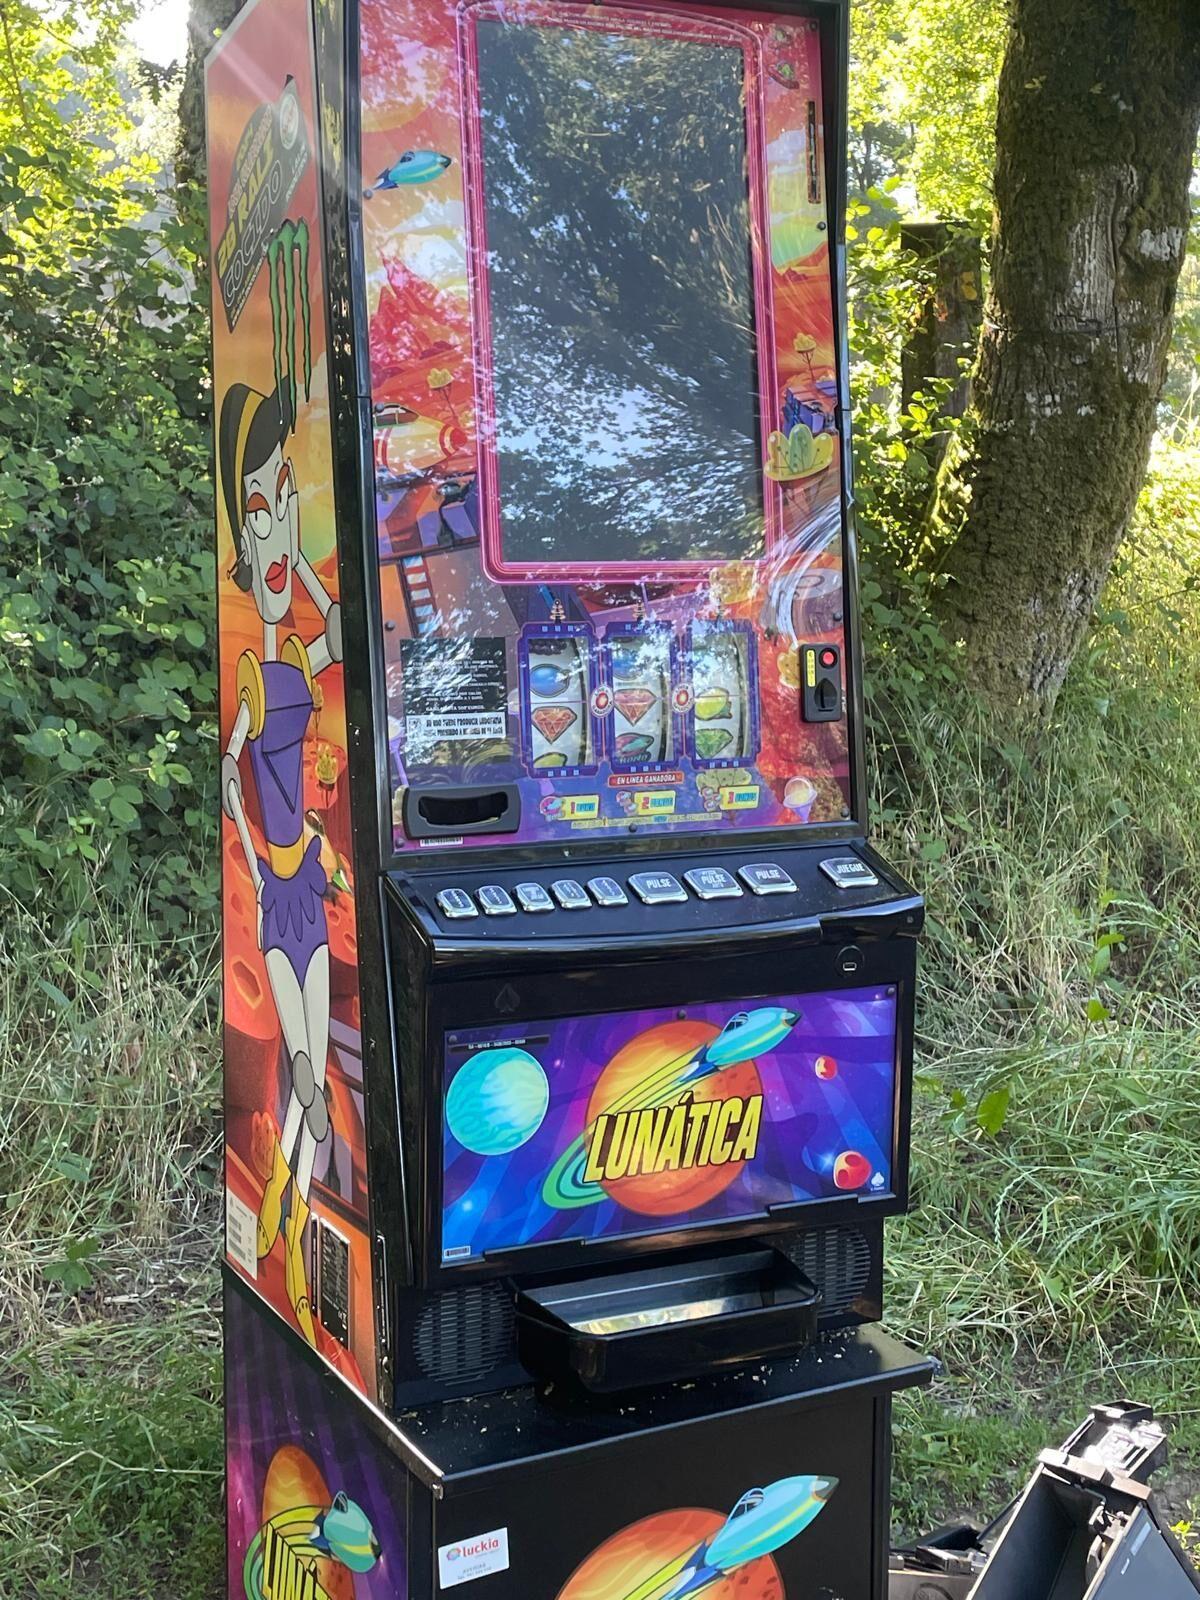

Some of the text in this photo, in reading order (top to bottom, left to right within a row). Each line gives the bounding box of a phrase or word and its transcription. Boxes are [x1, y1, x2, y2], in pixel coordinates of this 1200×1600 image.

[224, 160, 282, 307] COCIDO
[617, 776, 626, 785] EN
[644, 774, 676, 784] GANADORA
[641, 797, 650, 810] 2
[836, 863, 865, 874] JUEGUE
[701, 874, 727, 885] PULSE
[755, 869, 780, 880] PULSE
[646, 878, 671, 889] PULSE
[583, 1090, 764, 1184] LUNÁTICA
[462, 1538, 499, 1558] luckia
